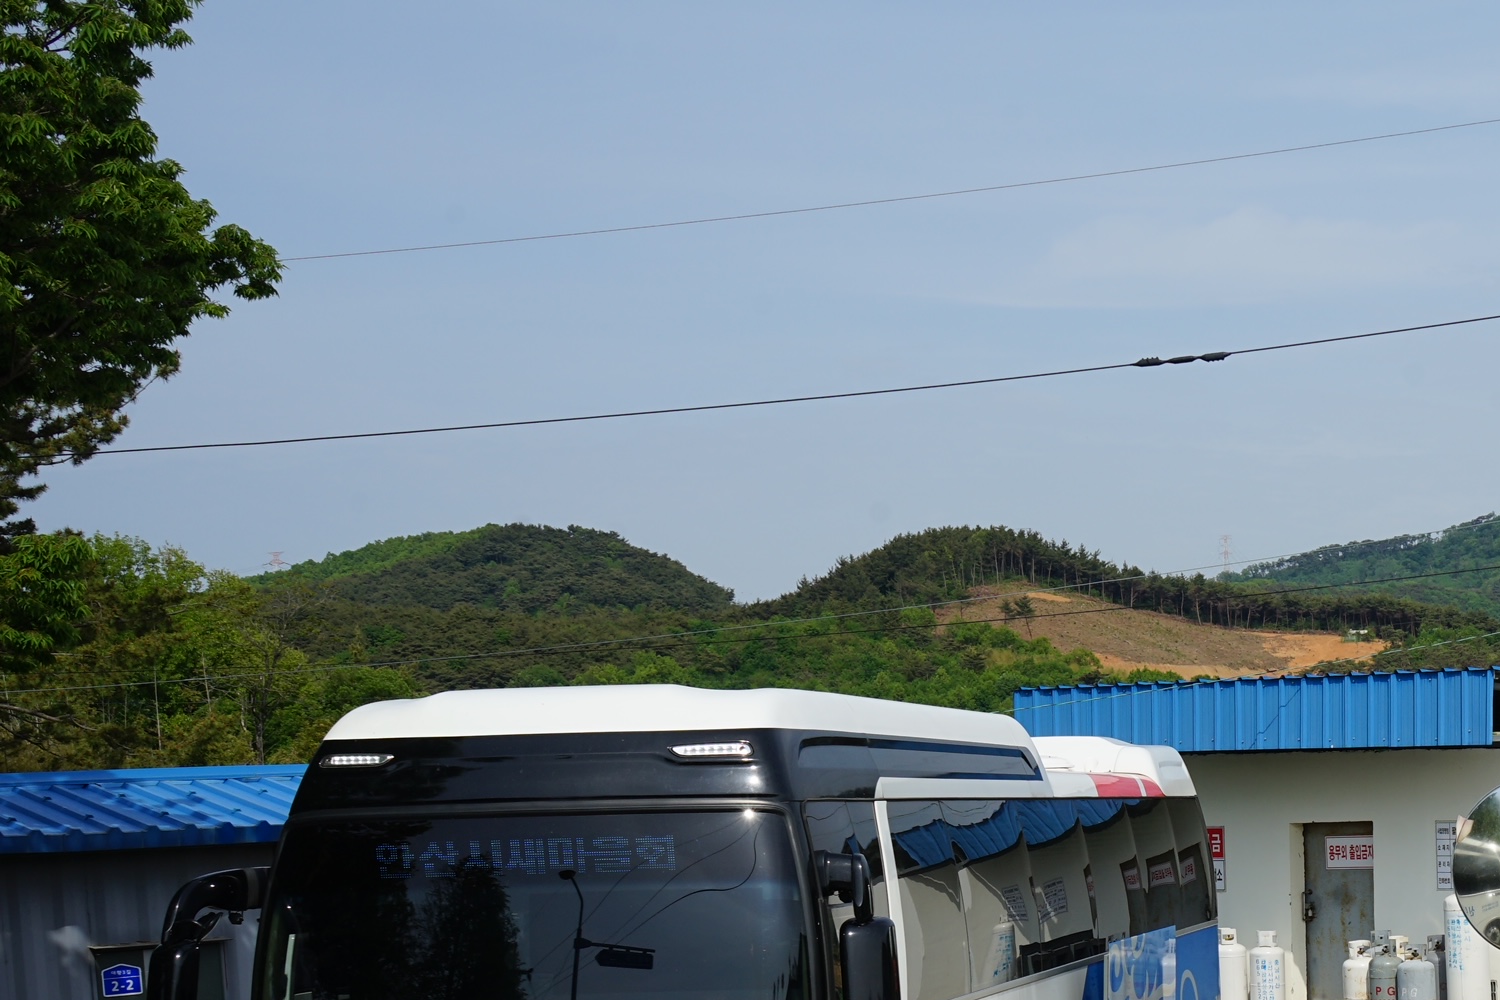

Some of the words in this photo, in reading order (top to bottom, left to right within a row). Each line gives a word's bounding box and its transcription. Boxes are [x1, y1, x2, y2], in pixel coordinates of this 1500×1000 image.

[375, 834, 676, 879] 안산시새마을회
[1328, 844, 1348, 861] 용무외
[111, 979, 135, 992] 2-2
